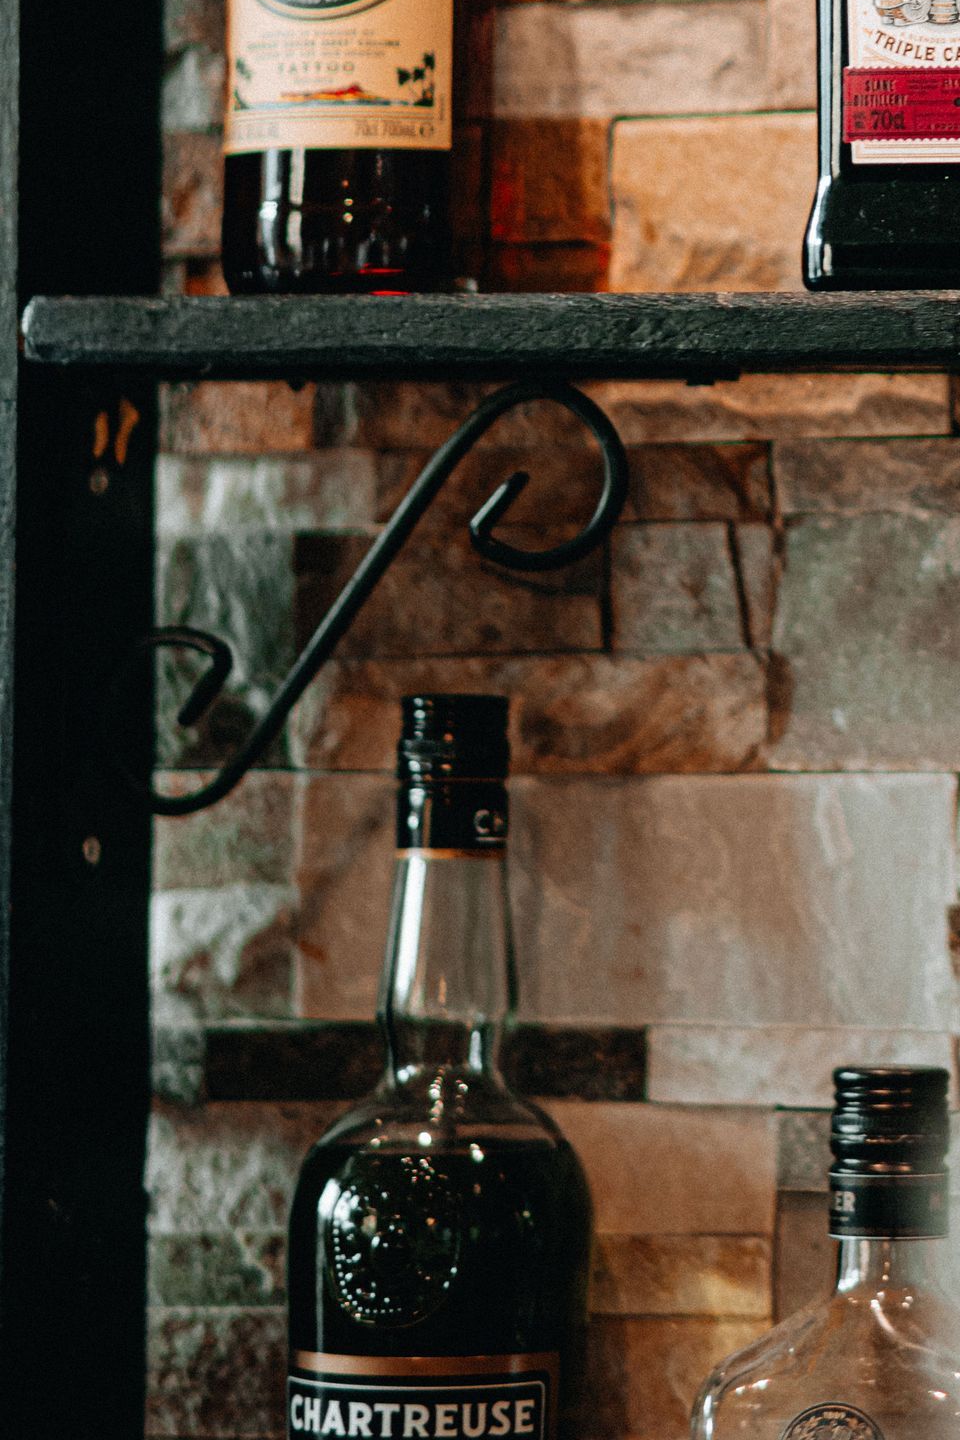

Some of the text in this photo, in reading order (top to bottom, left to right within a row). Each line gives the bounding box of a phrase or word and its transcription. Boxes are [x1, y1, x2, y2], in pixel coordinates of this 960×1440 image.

[874, 30, 935, 61] TRIPLE
[865, 79, 896, 92] SLANE
[290, 1393, 536, 1438] CHARTREUSE
